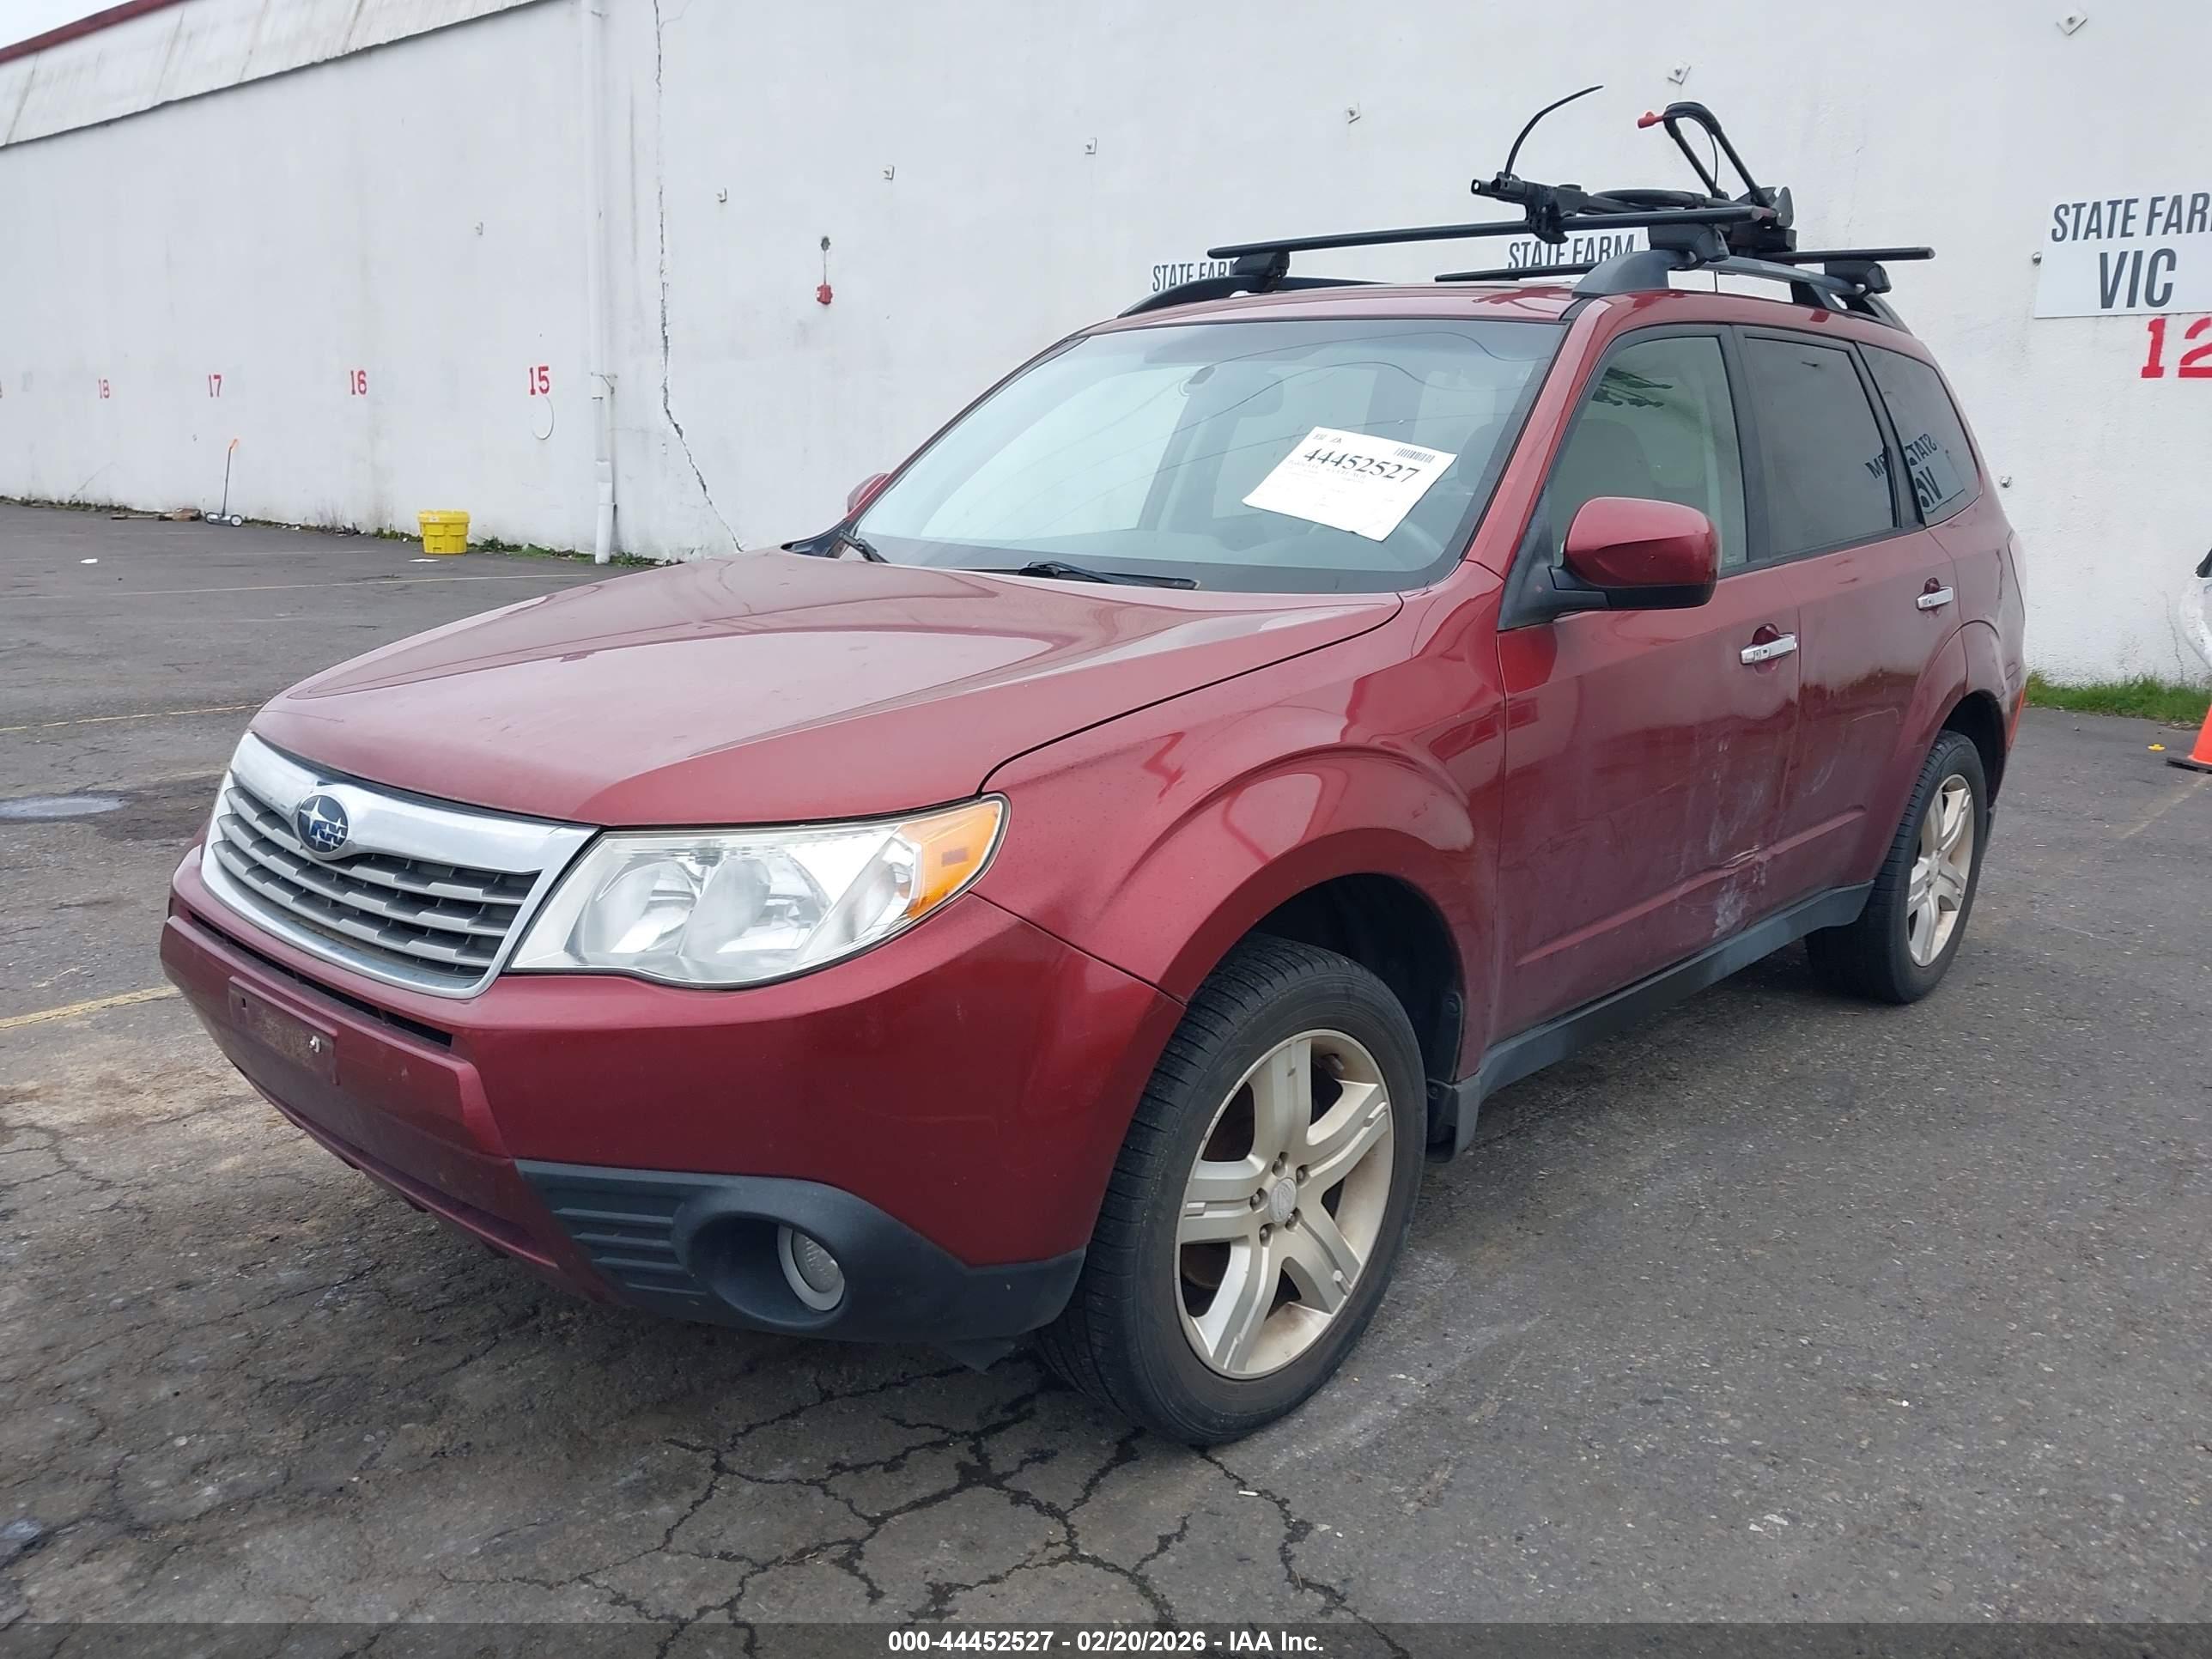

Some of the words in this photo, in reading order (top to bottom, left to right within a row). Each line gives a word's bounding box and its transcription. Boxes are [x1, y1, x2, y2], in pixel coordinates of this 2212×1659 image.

[2051, 198, 2138, 242] STATE
[2146, 192, 2212, 237] FAR
[1508, 240, 1565, 269] STATE
[1572, 234, 1635, 265] FARM
[1200, 259, 1234, 279] FAR
[2100, 247, 2177, 310] VIC
[2141, 317, 2212, 379] 12
[98, 378, 110, 399] 18
[208, 374, 222, 398] 17
[350, 369, 368, 395] 16
[529, 366, 550, 396] 15
[1304, 448, 1421, 483] 44452527
